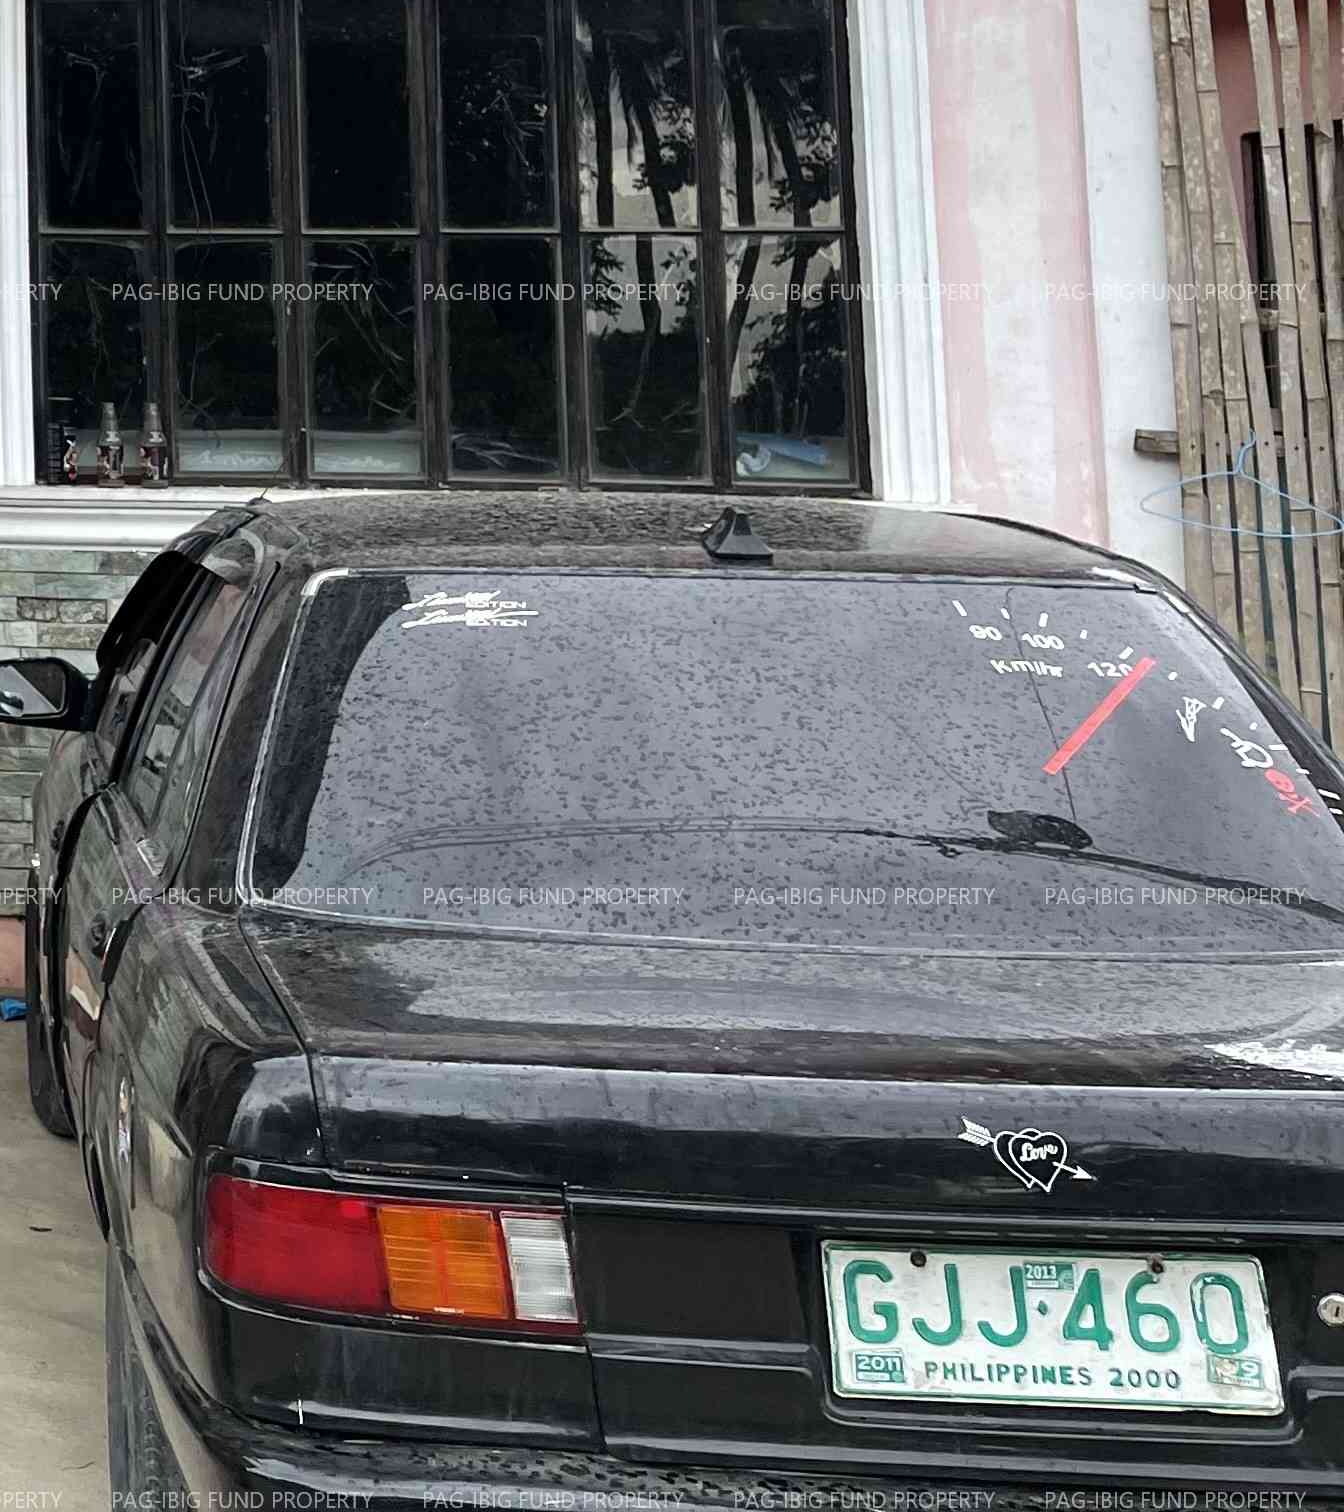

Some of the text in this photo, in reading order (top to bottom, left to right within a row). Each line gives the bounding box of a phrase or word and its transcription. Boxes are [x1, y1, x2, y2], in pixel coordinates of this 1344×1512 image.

[1021, 632, 1066, 651] 100
[1019, 1142, 1059, 1162] Love
[1024, 1263, 1057, 1280] 2013
[842, 1259, 1251, 1355] GJJ 460
[856, 1355, 902, 1372] 2011
[924, 1360, 1093, 1387] PHILIPPINES
[1109, 1367, 1183, 1390] 2000
